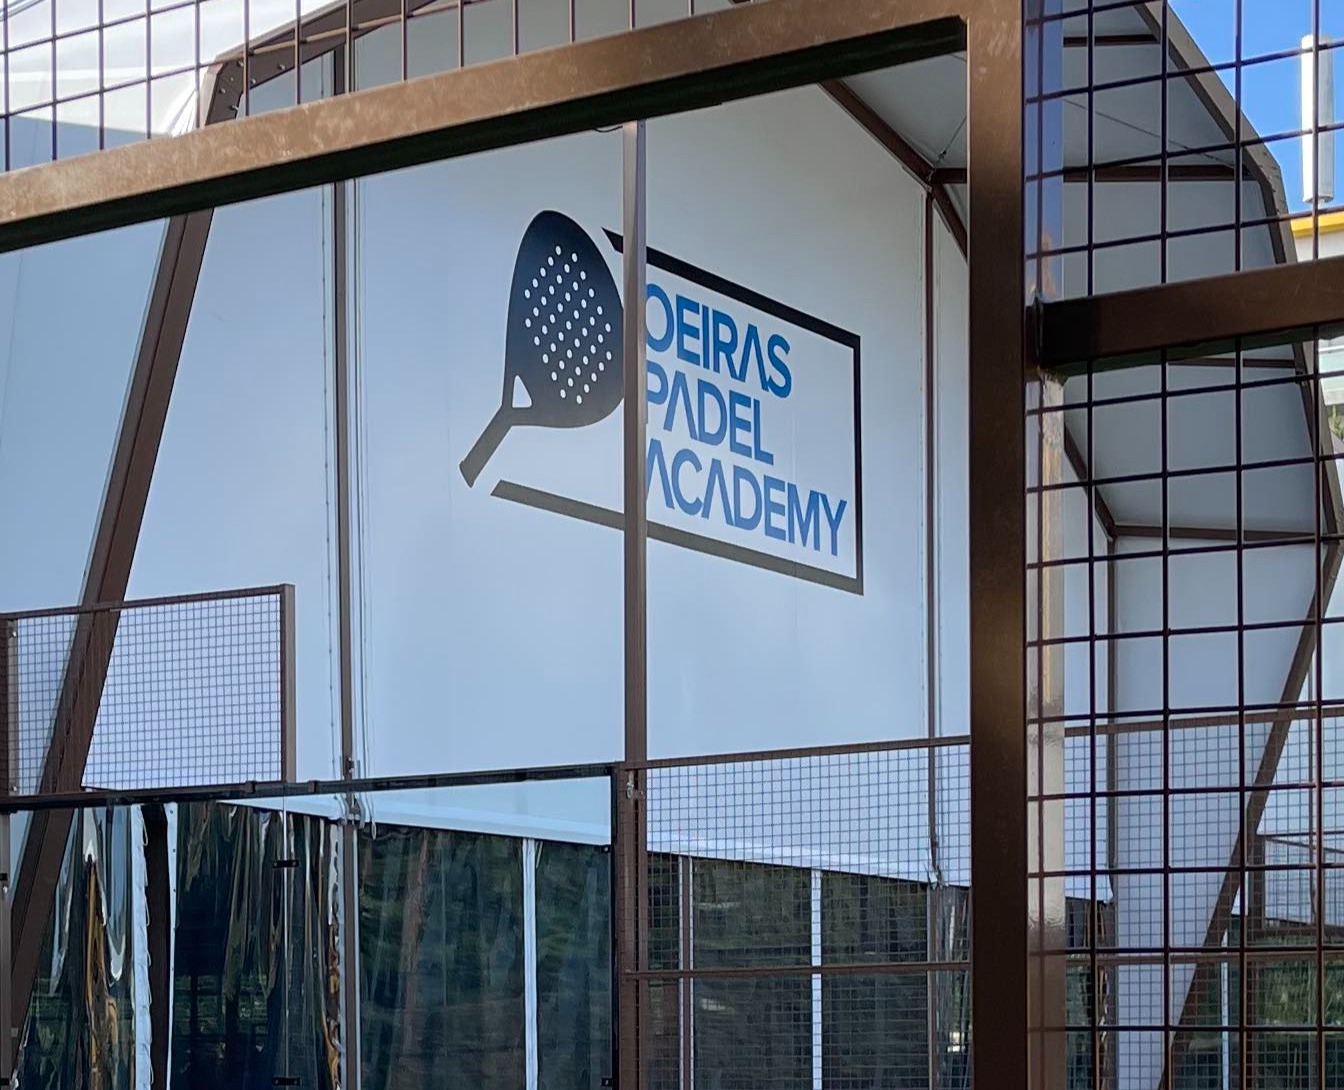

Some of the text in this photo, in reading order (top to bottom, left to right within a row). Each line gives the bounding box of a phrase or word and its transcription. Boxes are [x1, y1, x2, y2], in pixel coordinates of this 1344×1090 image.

[646, 283, 792, 398] OEIRAS
[646, 360, 774, 466] PADEL
[646, 439, 847, 556] ACADEMY
